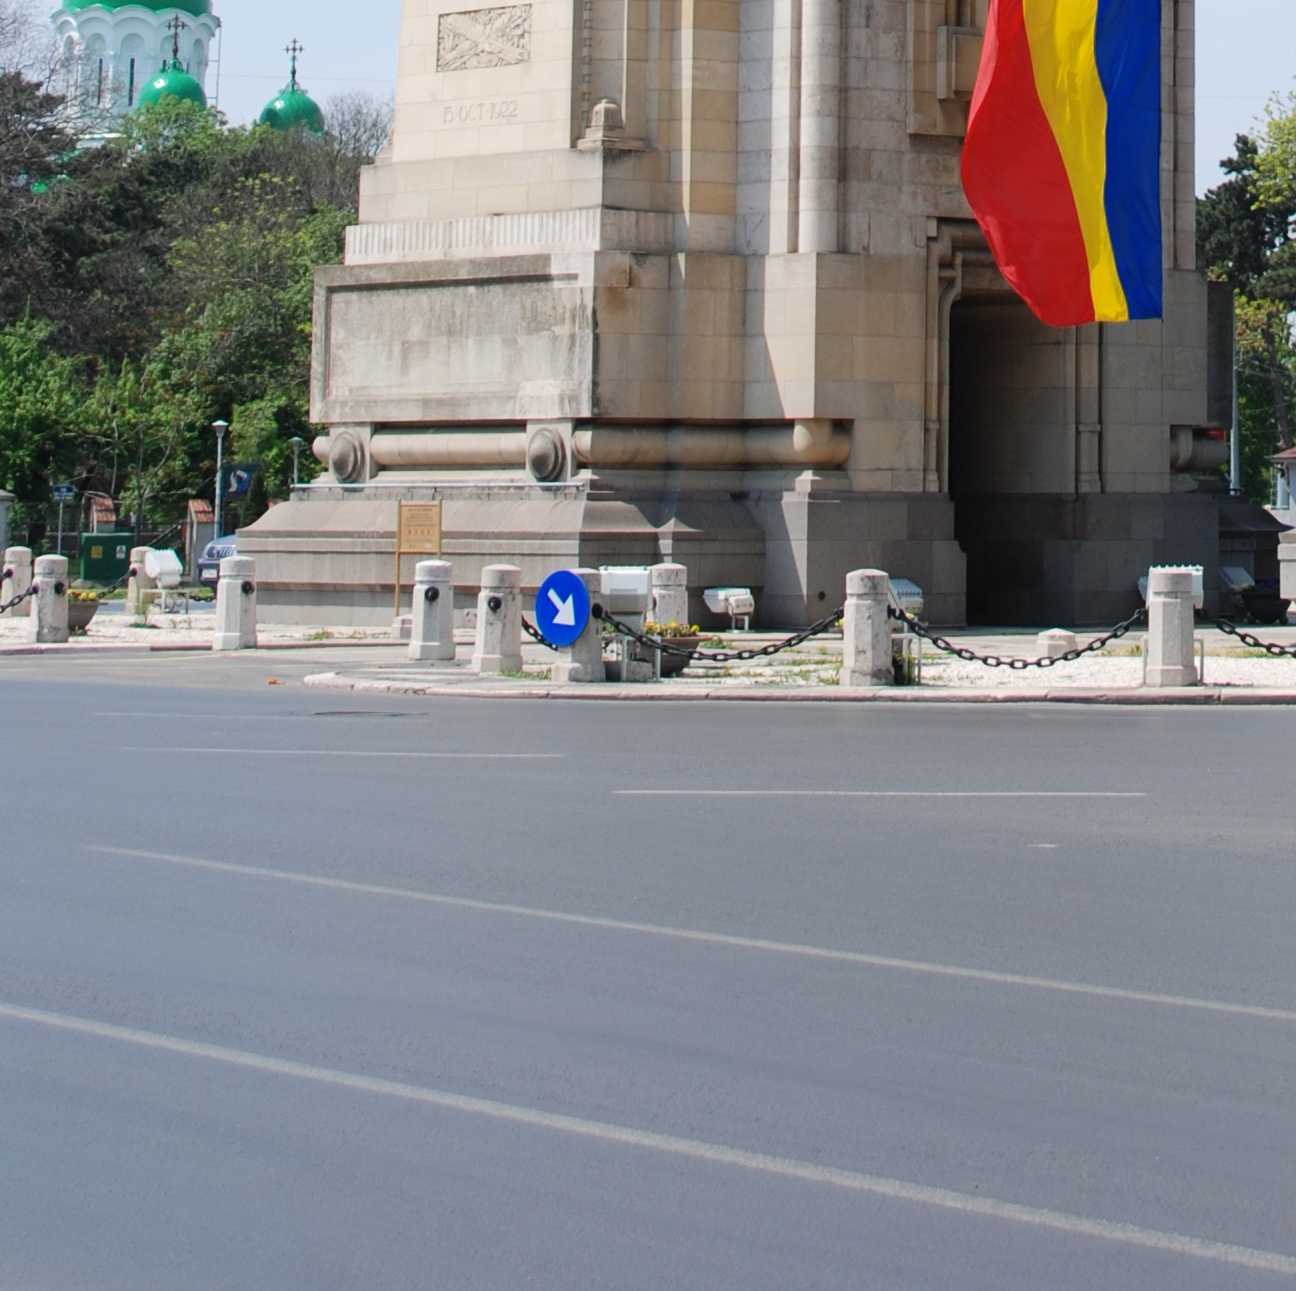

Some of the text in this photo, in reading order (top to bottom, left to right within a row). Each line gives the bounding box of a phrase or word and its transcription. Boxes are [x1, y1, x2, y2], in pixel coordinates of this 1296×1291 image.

[444, 100, 518, 123] 15 OCT 1922
